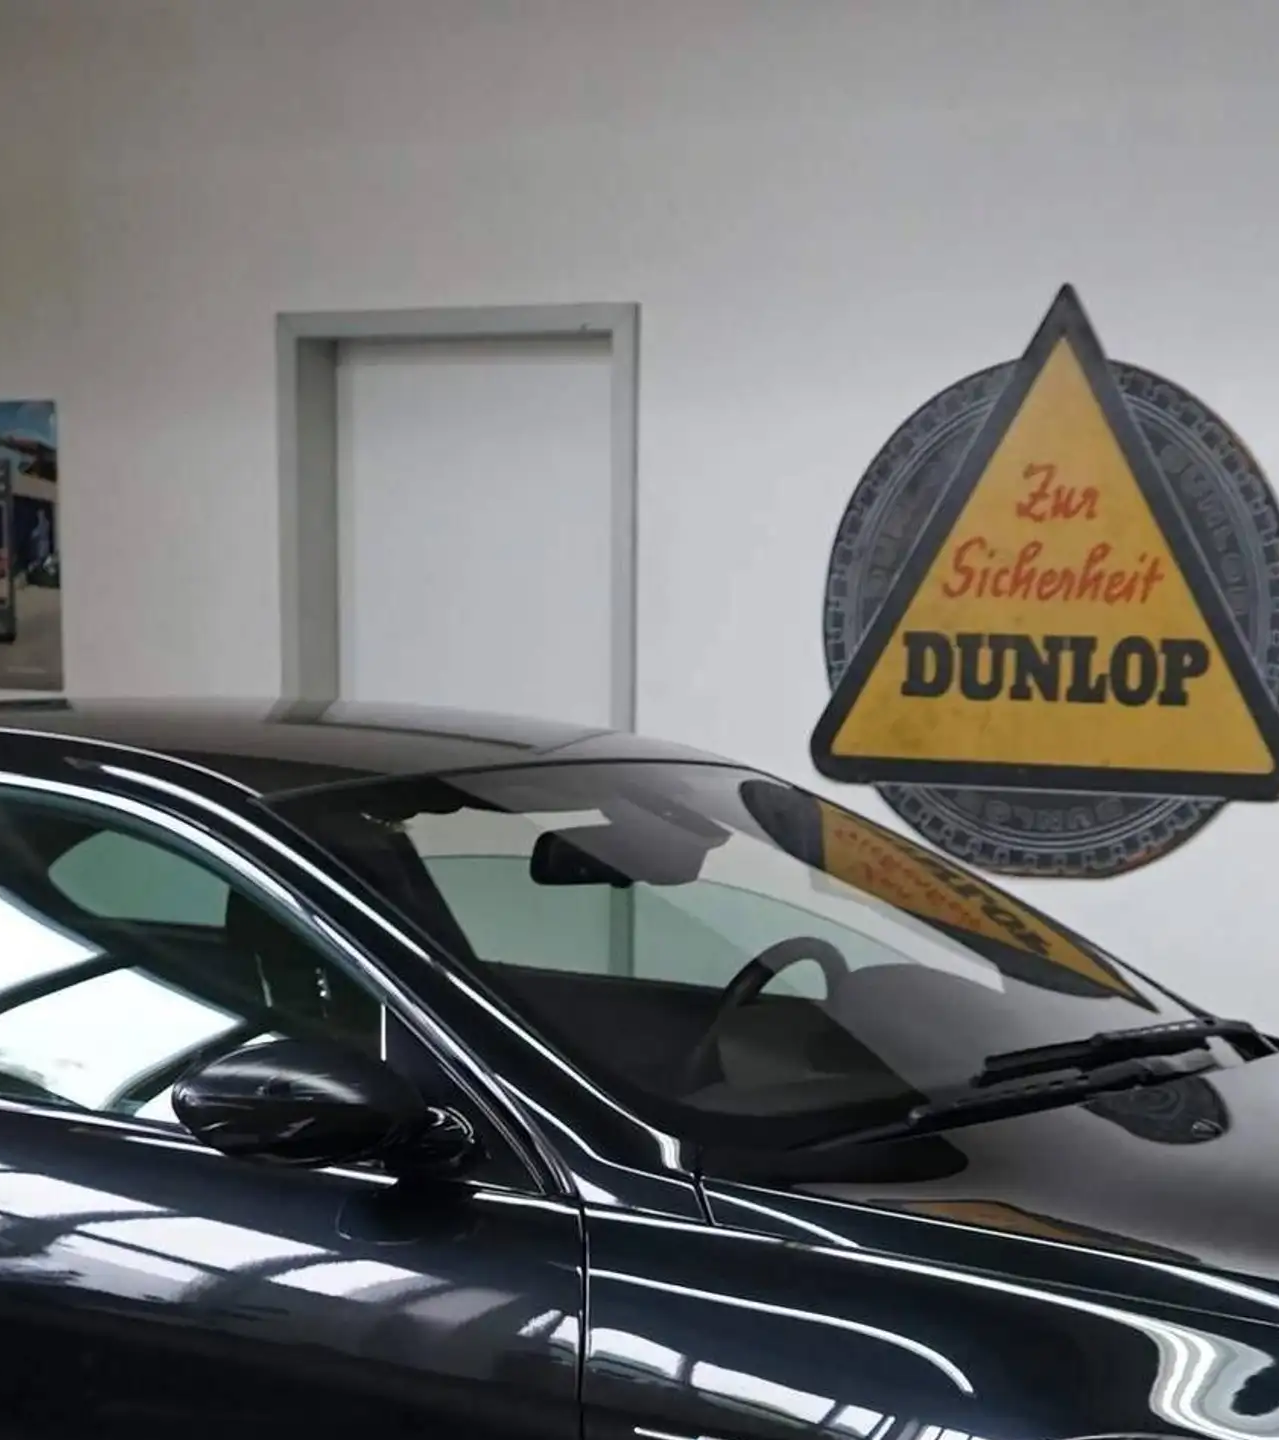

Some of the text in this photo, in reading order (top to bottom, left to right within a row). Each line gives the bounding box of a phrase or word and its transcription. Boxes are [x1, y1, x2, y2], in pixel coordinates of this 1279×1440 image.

[1016, 463, 1100, 523] Zur
[942, 536, 1165, 605] Sicherheit
[900, 630, 1210, 707] DUNLOP
